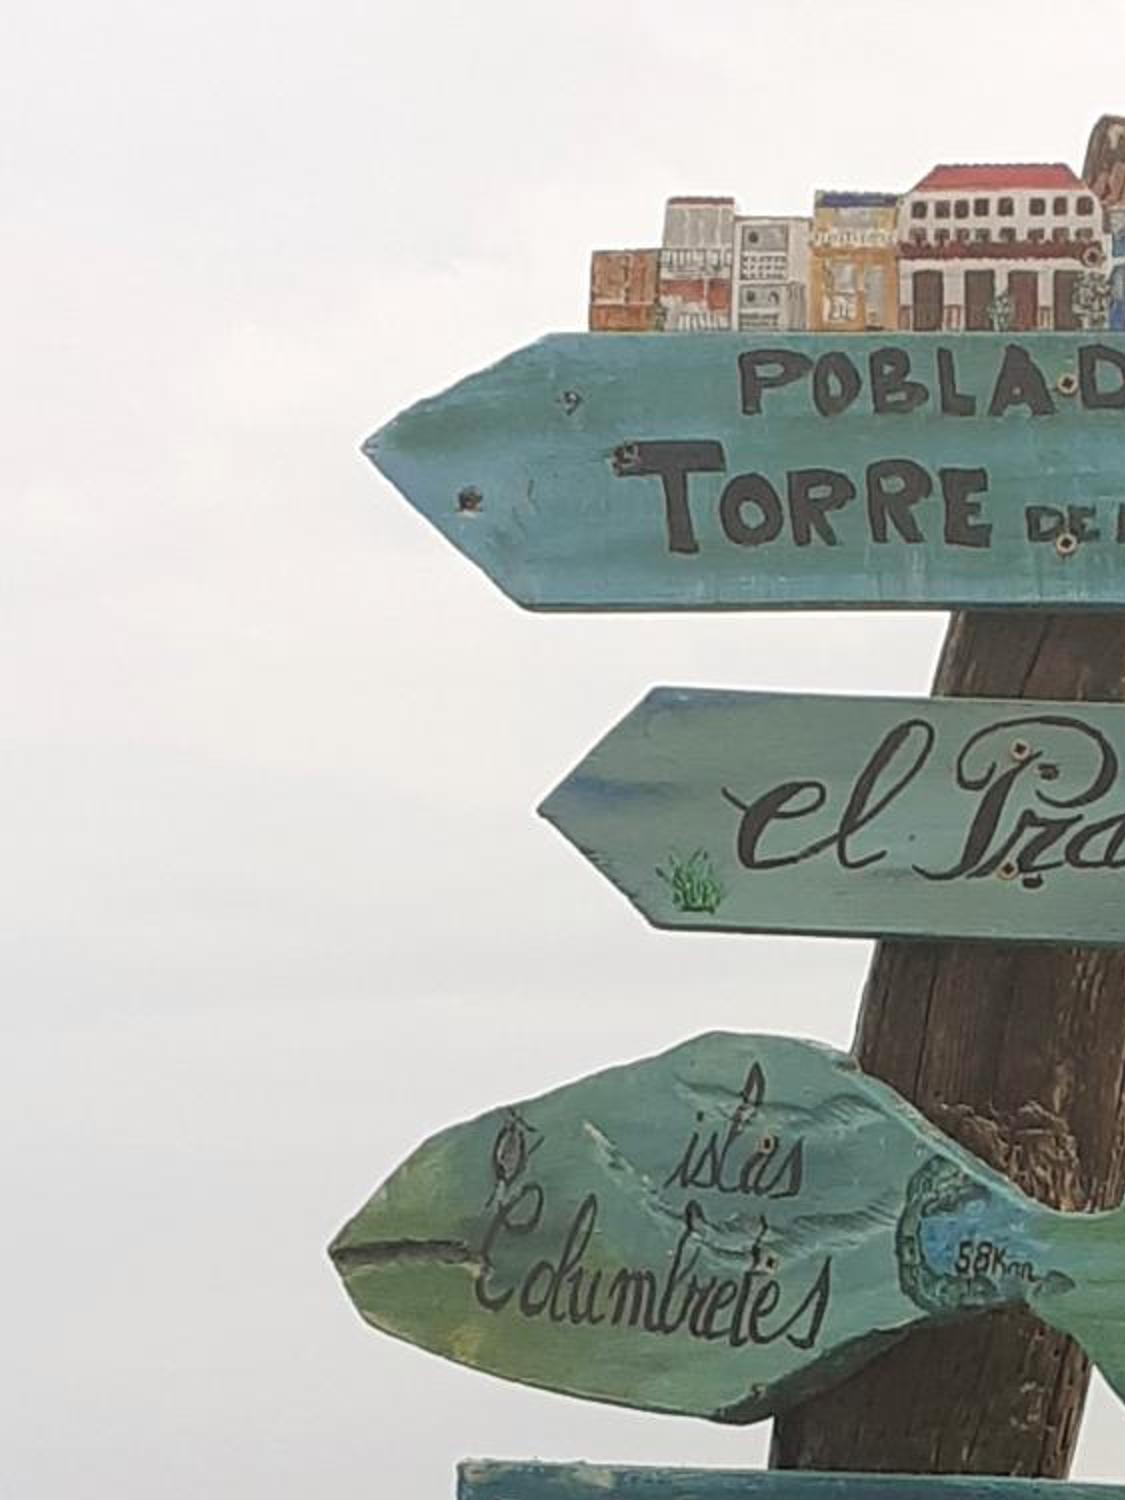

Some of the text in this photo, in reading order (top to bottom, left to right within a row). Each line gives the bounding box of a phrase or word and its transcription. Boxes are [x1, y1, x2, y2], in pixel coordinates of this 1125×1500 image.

[612, 439, 992, 553] TORRE
[1024, 503, 1100, 545] DE
[721, 717, 936, 871] el
